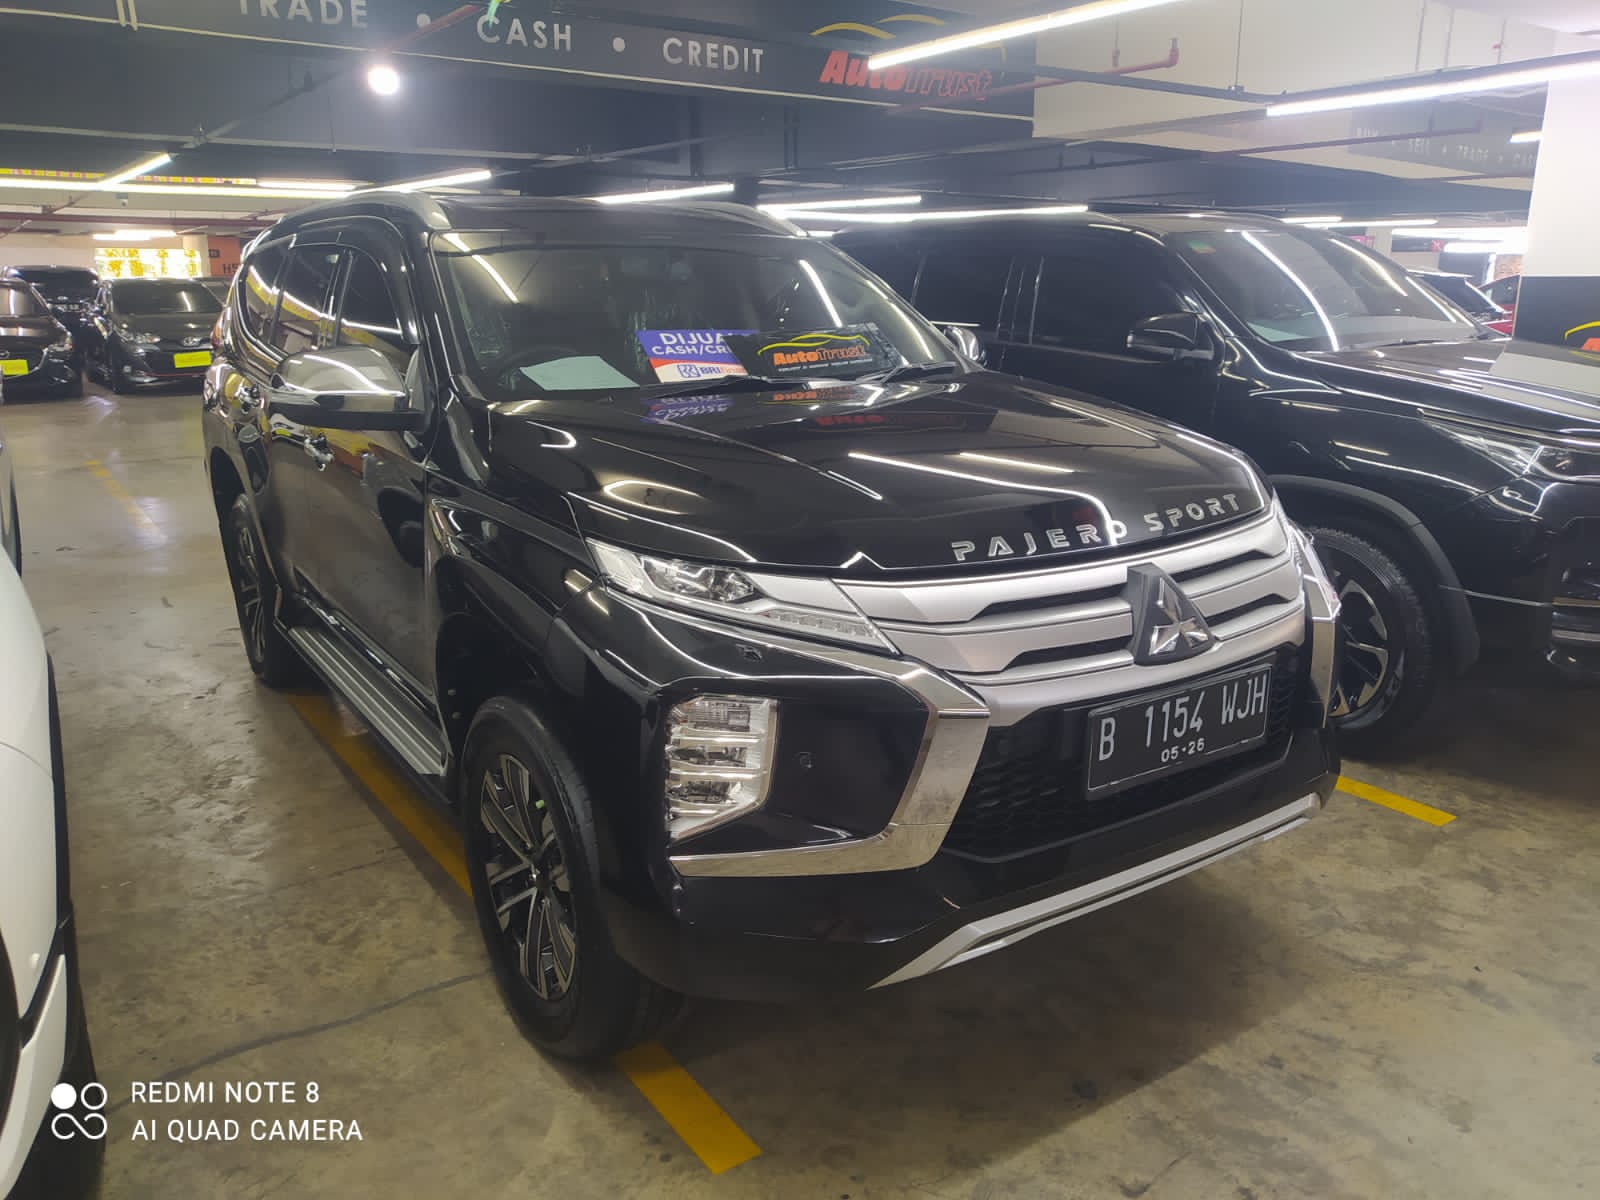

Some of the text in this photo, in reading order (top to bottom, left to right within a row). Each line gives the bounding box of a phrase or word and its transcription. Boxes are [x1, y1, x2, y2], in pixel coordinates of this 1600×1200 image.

[476, 14, 573, 52] CASH
[662, 38, 765, 74] CREDIT
[658, 332, 735, 345] DIJUA
[951, 493, 1240, 562] PAJERO SPORT
[1098, 673, 1267, 761] B 1154 WJH
